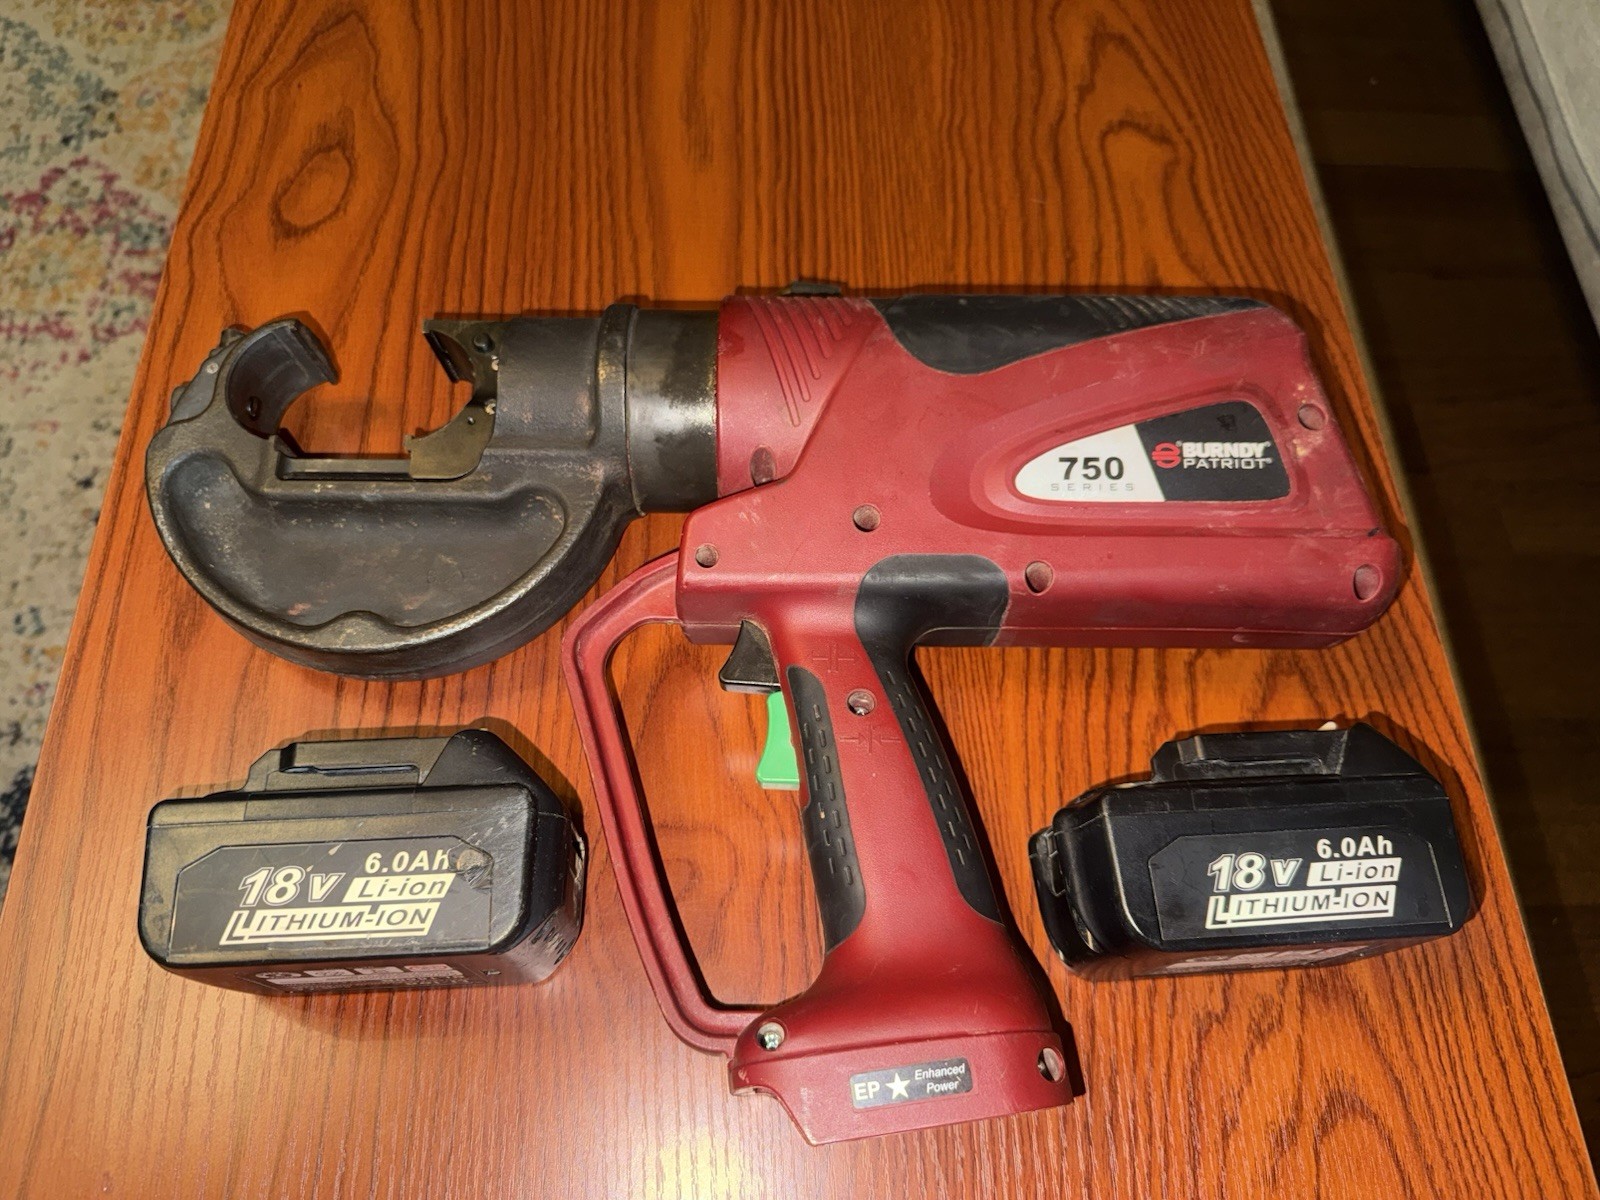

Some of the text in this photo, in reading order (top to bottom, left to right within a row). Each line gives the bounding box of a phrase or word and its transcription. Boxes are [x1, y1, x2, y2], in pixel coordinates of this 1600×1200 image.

[1058, 456, 1124, 480] 750
[1050, 483, 1134, 492] SERIES
[1316, 835, 1392, 859] 6.0Ah
[365, 849, 449, 874] 6.0Ah
[1321, 863, 1395, 882] Li-ion
[357, 878, 447, 899] Li-ion
[914, 1062, 966, 1081] Enhanced
[853, 1080, 881, 1101] EP
[926, 1080, 960, 1094] Power
